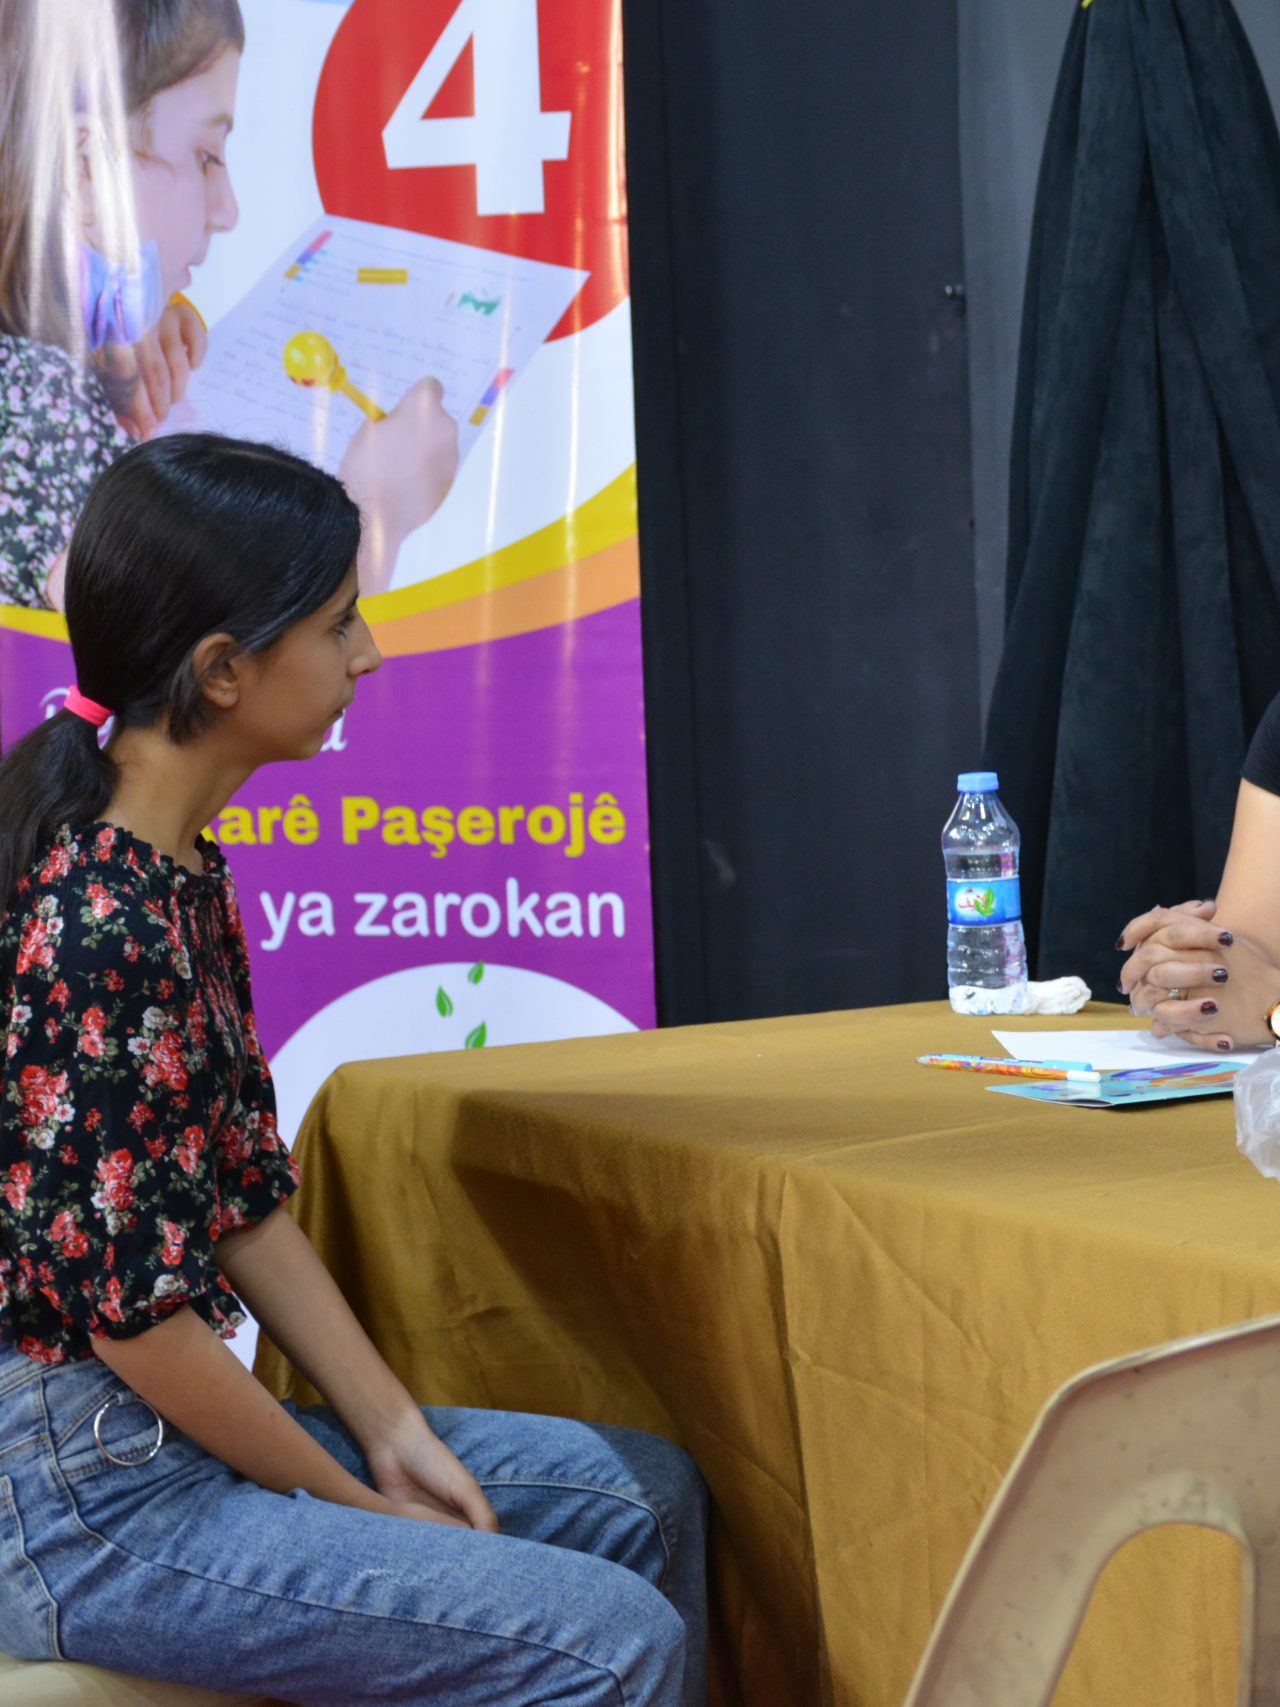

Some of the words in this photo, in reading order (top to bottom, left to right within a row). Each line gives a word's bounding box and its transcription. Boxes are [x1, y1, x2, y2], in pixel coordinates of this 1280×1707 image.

[381, 0, 572, 216] 4
[200, 794, 320, 845] arê
[341, 792, 626, 858] Paşerojê
[259, 891, 335, 951] ya
[354, 877, 625, 938] zarokan
